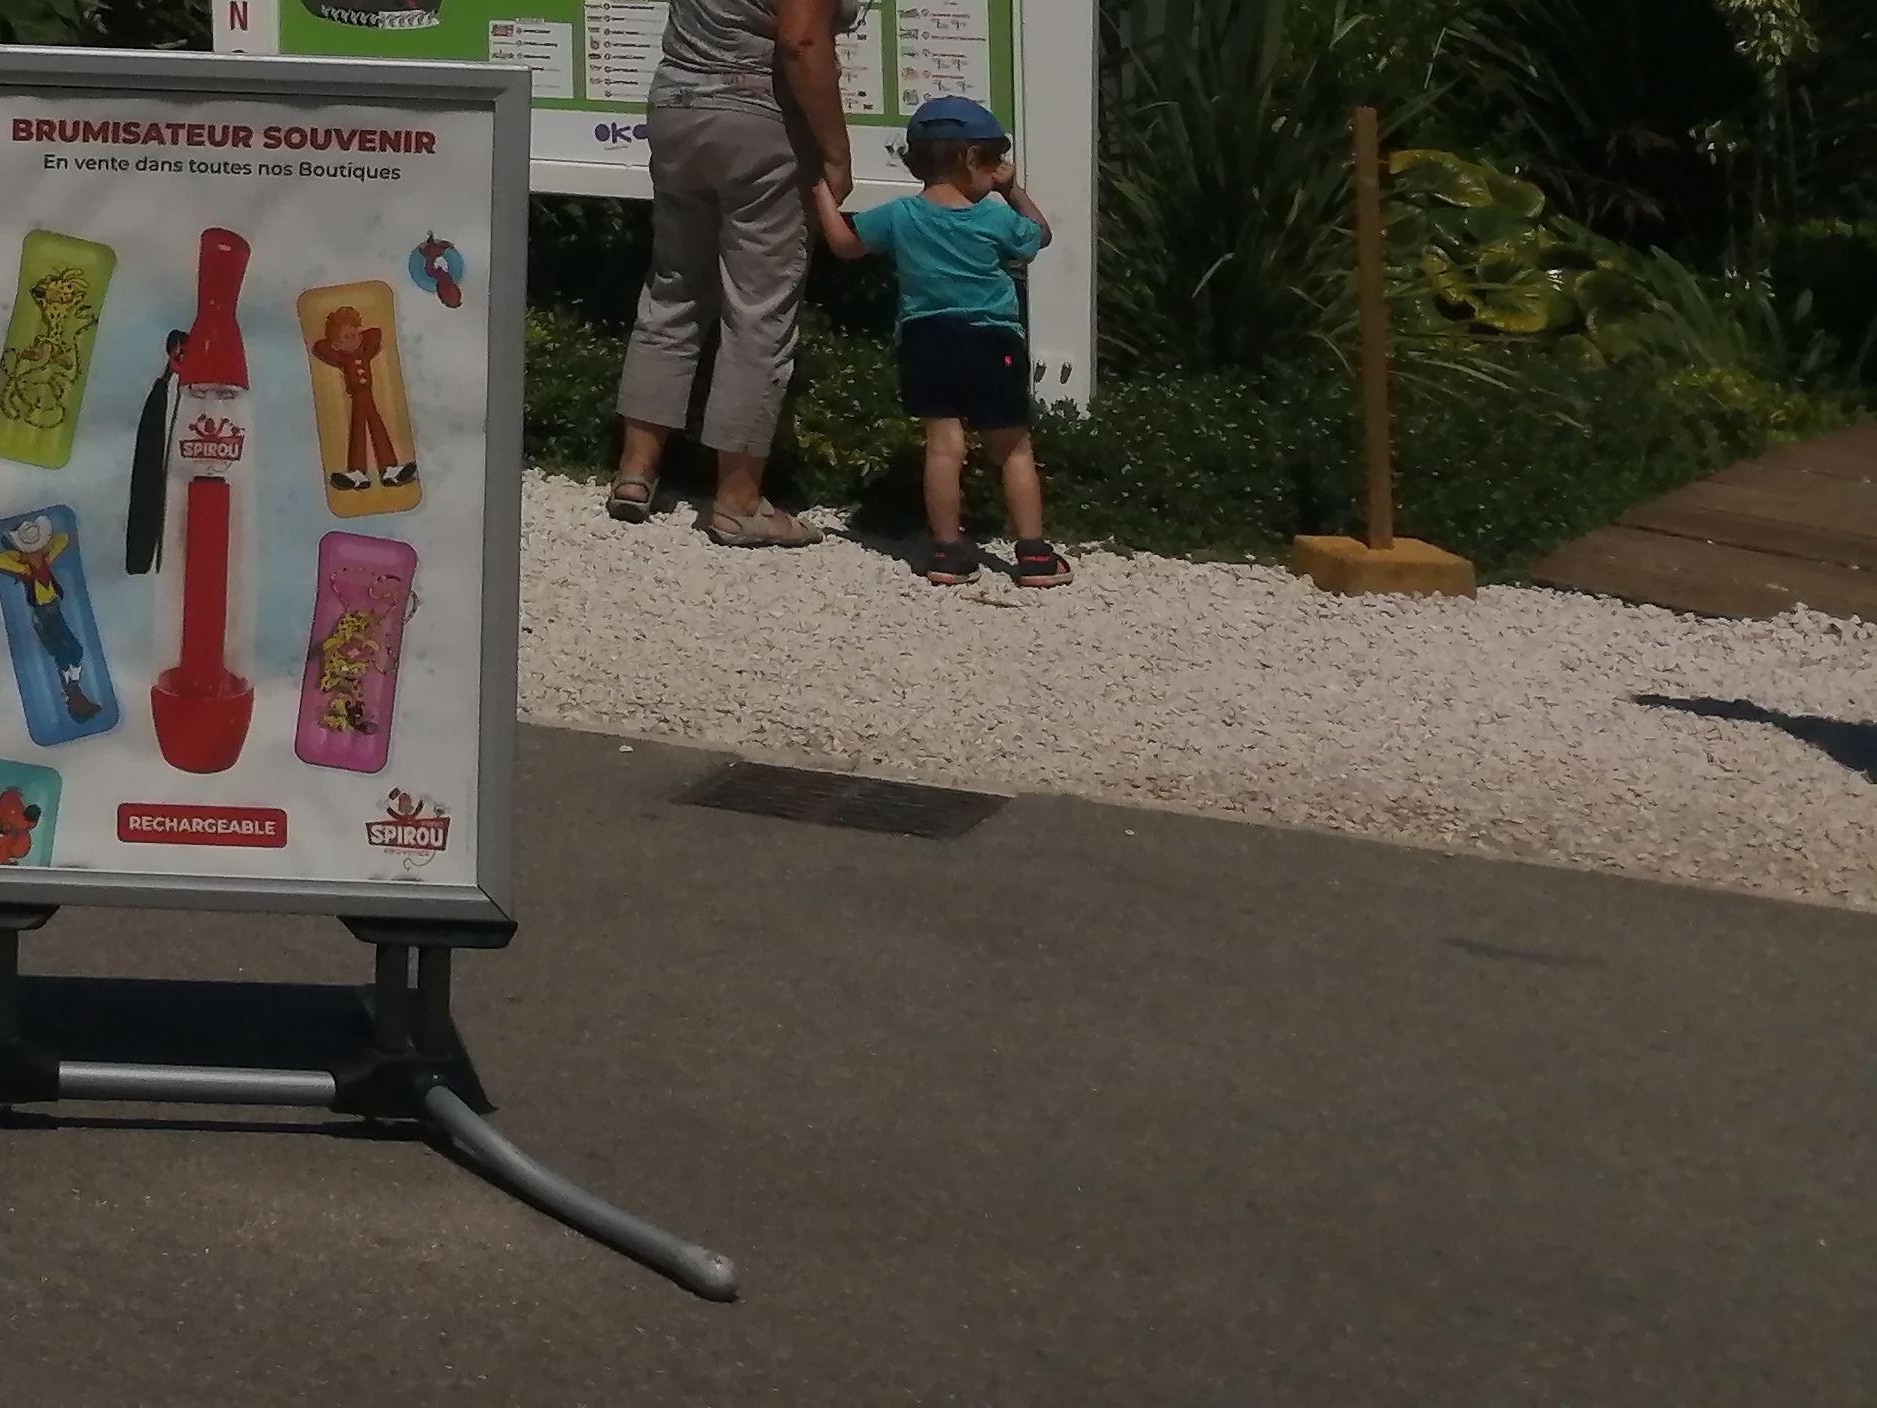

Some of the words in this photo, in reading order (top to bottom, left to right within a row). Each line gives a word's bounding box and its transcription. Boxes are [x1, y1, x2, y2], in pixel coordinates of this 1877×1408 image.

[11, 118, 254, 149] BRUMISATEUR
[262, 125, 437, 155] SOUVENIR
[43, 153, 69, 170] En
[74, 157, 130, 172] vente
[135, 155, 184, 173] dans
[189, 158, 253, 176] toutes
[257, 162, 294, 177] nos
[298, 160, 402, 183] Boutiques
[182, 441, 241, 458] SPIROU
[128, 814, 278, 836] RECHARGEABLE
[370, 824, 444, 848] SPIROU
